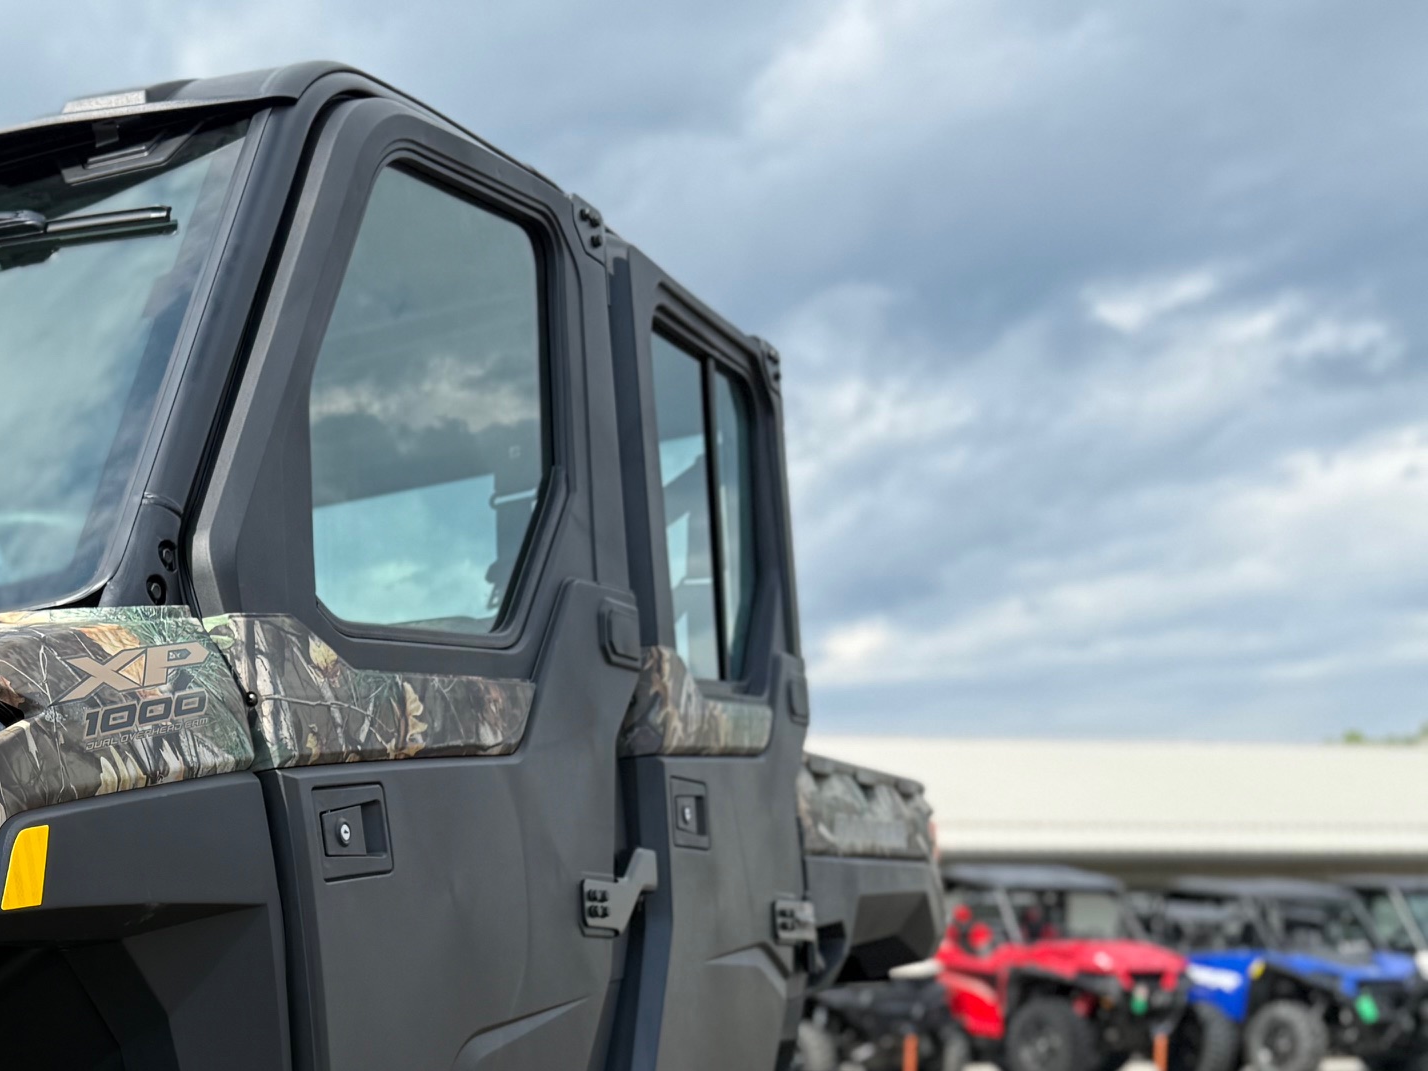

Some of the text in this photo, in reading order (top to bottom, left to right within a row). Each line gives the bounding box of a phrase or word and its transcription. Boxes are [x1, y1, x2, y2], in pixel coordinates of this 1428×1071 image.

[49, 642, 211, 705] XP
[84, 690, 209, 738] 1000
[85, 737, 118, 752] DUAL
[120, 723, 183, 744] OVERHEAD
